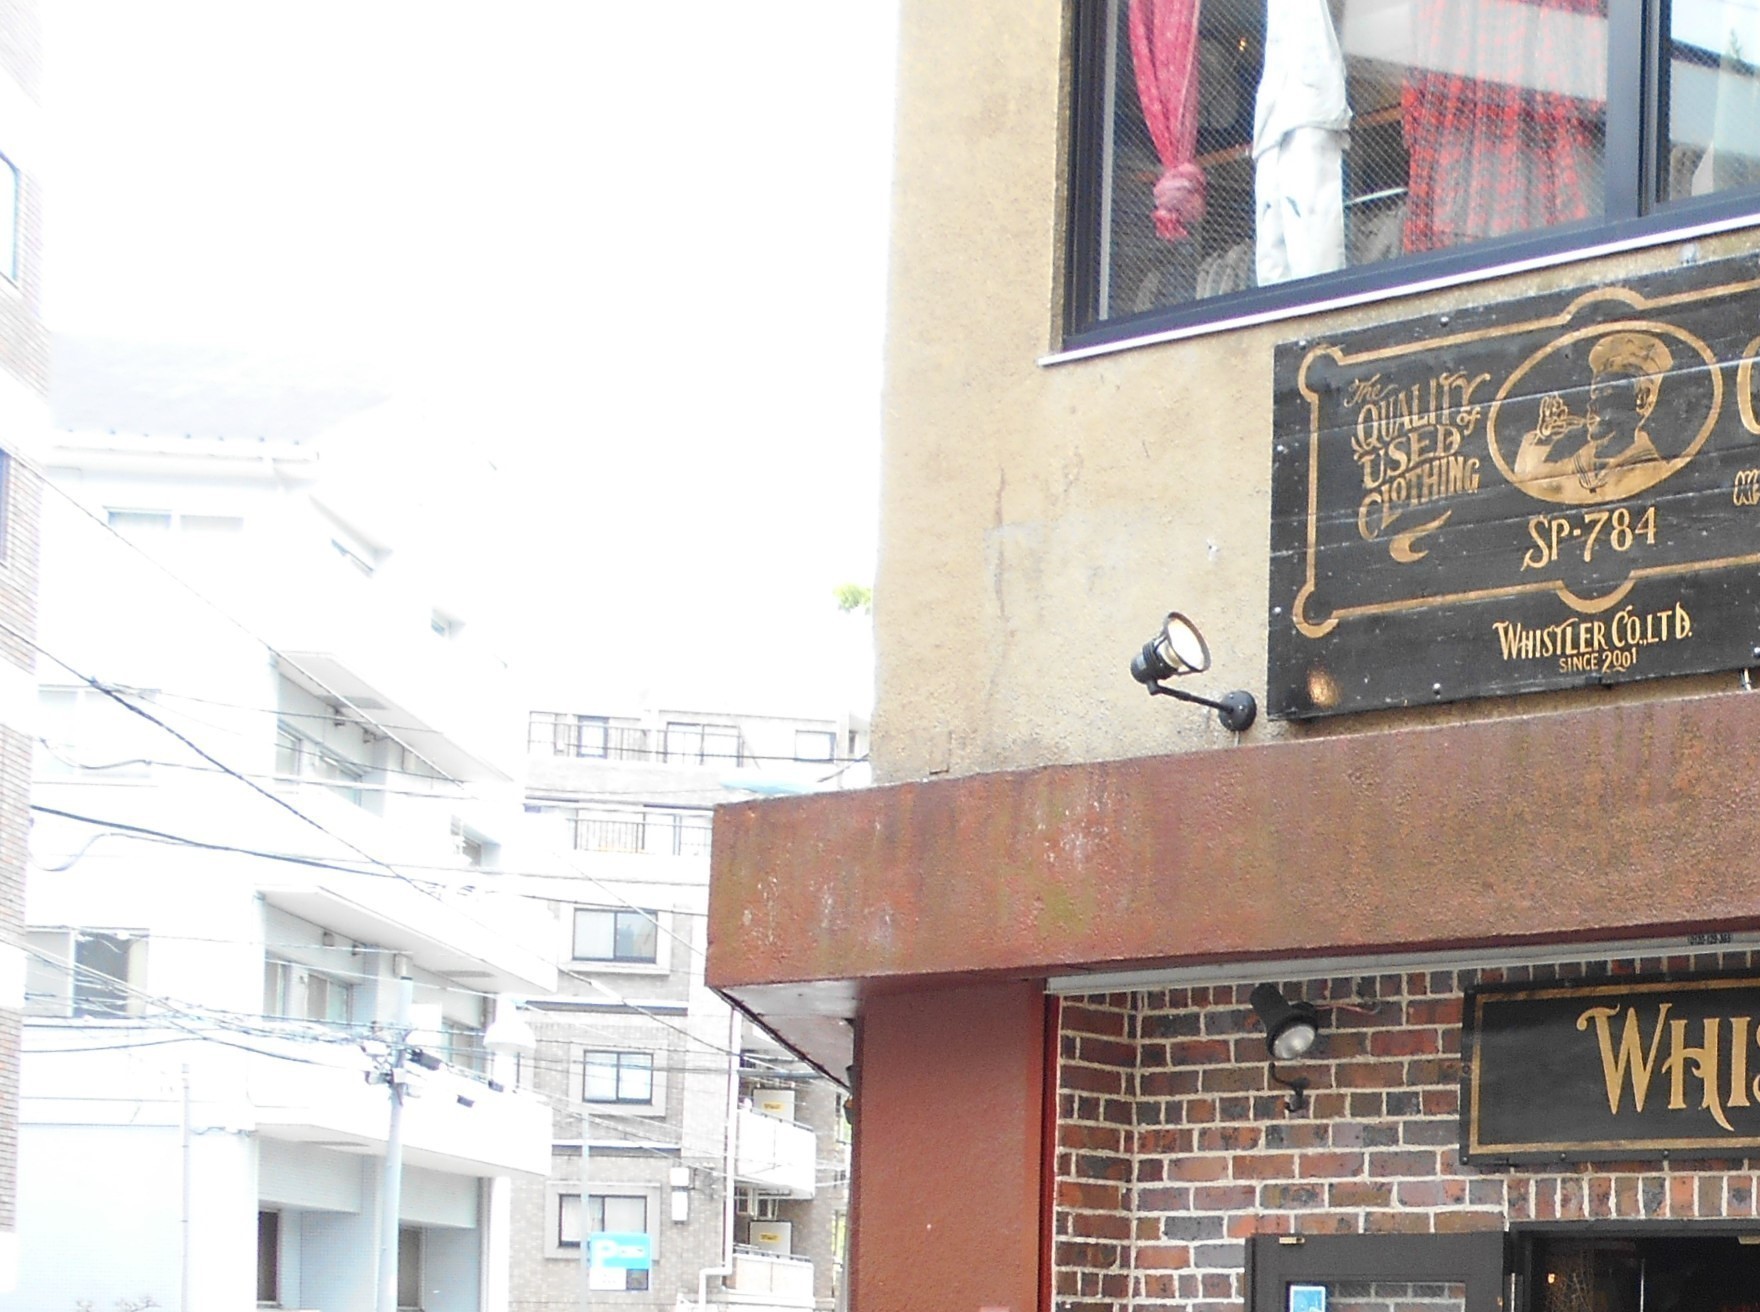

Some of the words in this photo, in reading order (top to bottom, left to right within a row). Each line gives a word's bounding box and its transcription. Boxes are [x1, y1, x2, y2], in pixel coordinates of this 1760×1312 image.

[1344, 373, 1398, 407] The
[1351, 371, 1491, 452] QUALITY
[1456, 406, 1481, 436] of
[1353, 424, 1461, 489] USED
[1358, 456, 1480, 542] CLOTHING
[1492, 617, 1608, 661] WHISTLER
[1559, 653, 1599, 673] SINCE
[1602, 647, 1637, 673] 2001
